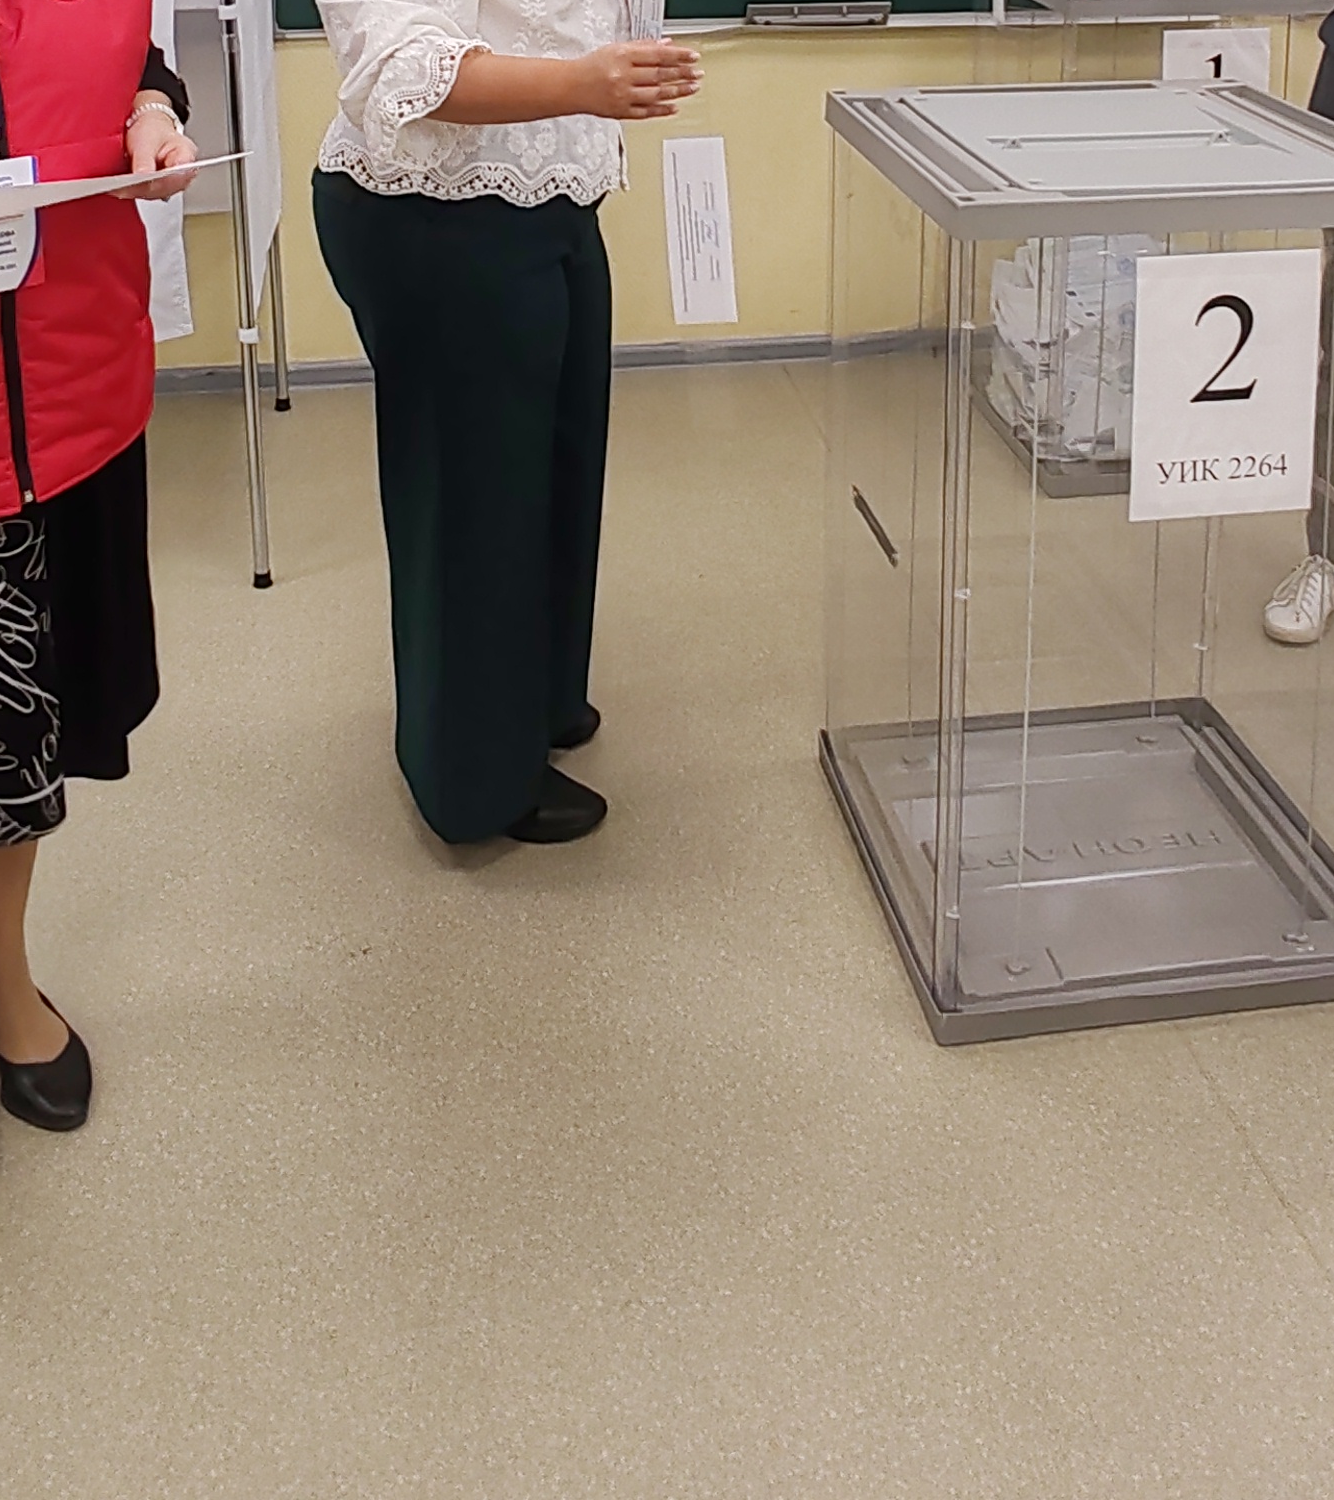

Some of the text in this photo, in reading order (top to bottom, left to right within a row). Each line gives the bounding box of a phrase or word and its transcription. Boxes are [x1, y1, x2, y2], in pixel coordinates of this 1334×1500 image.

[1204, 52, 1222, 78] 1
[1189, 294, 1257, 404] 2
[1156, 453, 1288, 485] УИК 2264
